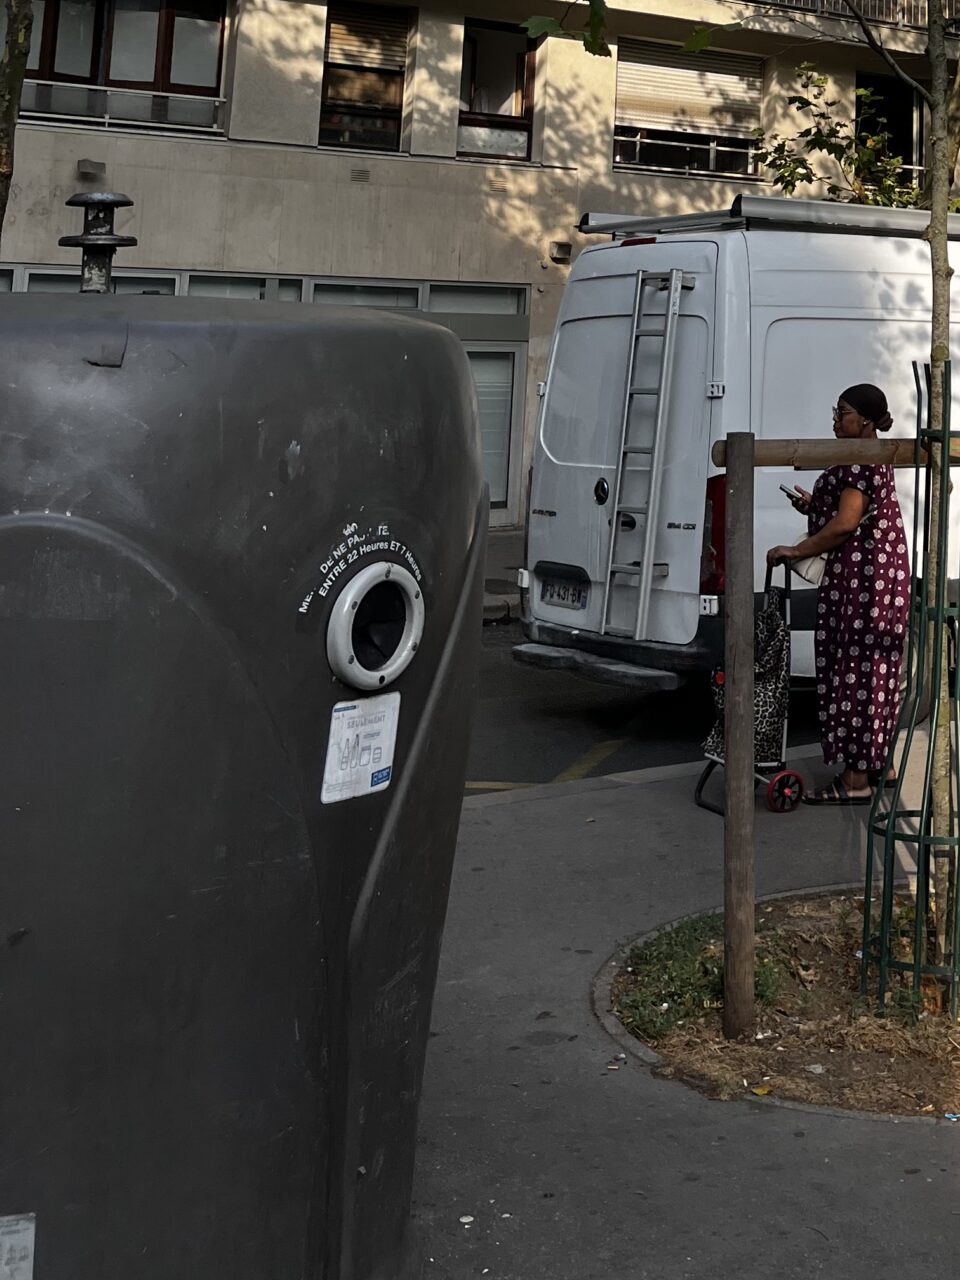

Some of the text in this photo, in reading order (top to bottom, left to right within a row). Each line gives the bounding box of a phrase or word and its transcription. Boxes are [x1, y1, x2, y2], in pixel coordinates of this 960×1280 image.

[319, 541, 422, 597] ENTRE 22 Heures ET 7 Heures
[333, 543, 348, 560] NE
